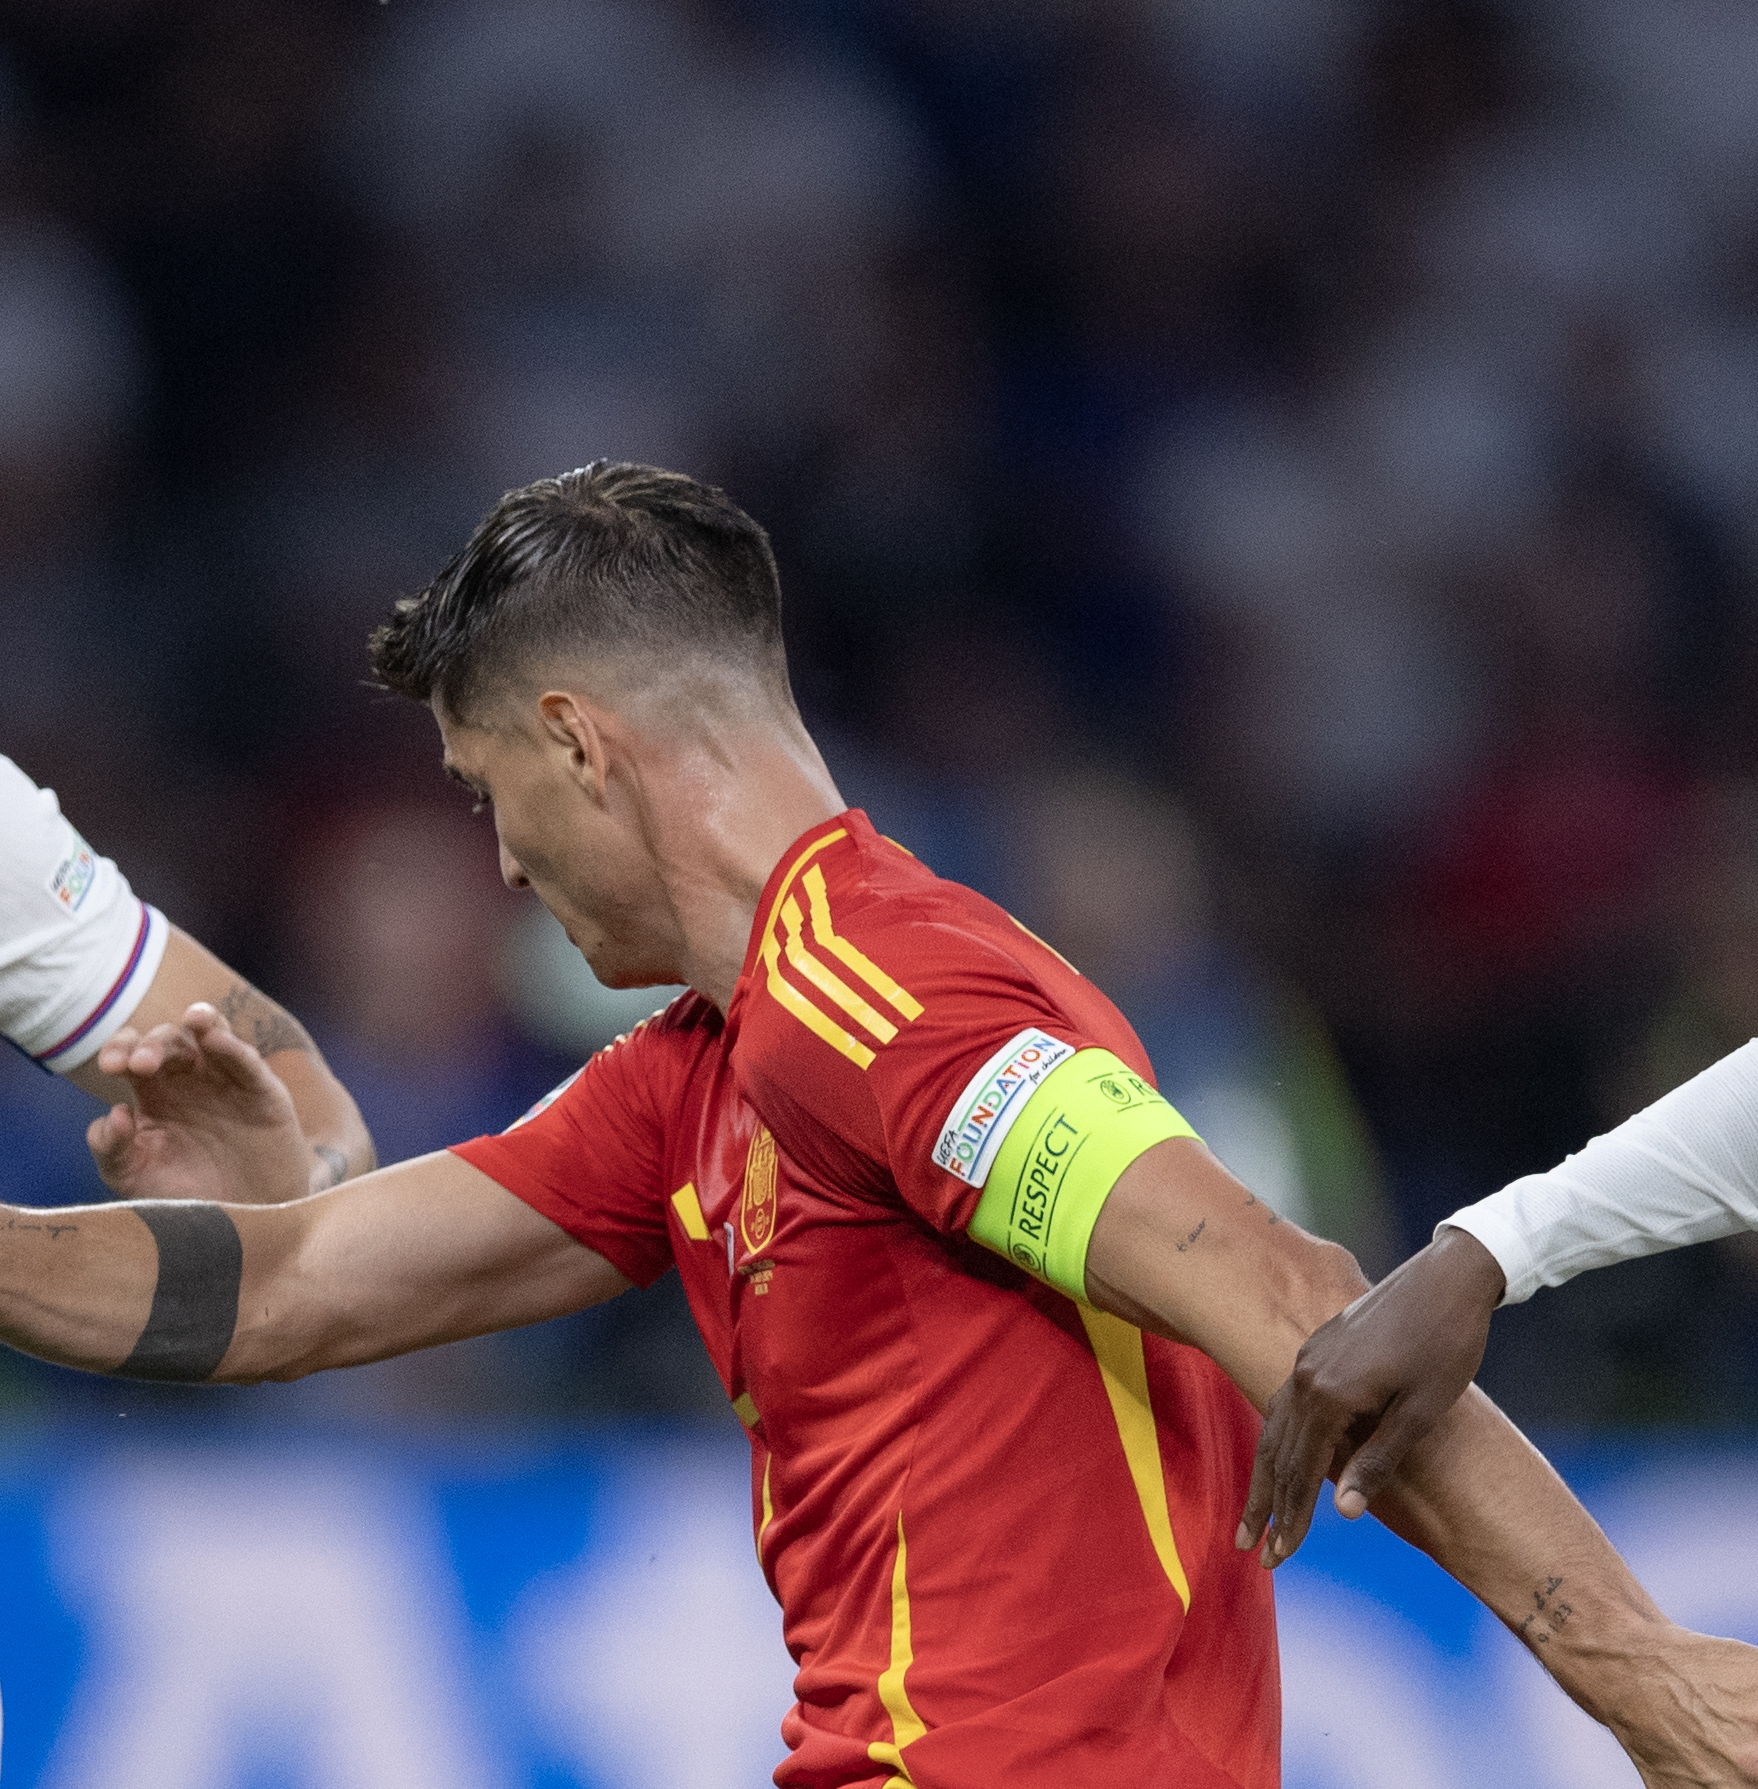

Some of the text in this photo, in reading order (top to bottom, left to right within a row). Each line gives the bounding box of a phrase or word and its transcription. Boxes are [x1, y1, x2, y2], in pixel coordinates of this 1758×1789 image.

[949, 1037, 1056, 1178] FOUNDATION
[1028, 1047, 1068, 1086] for children
[935, 1129, 958, 1166] UEFA
[1018, 1113, 1079, 1241] RESPECT
